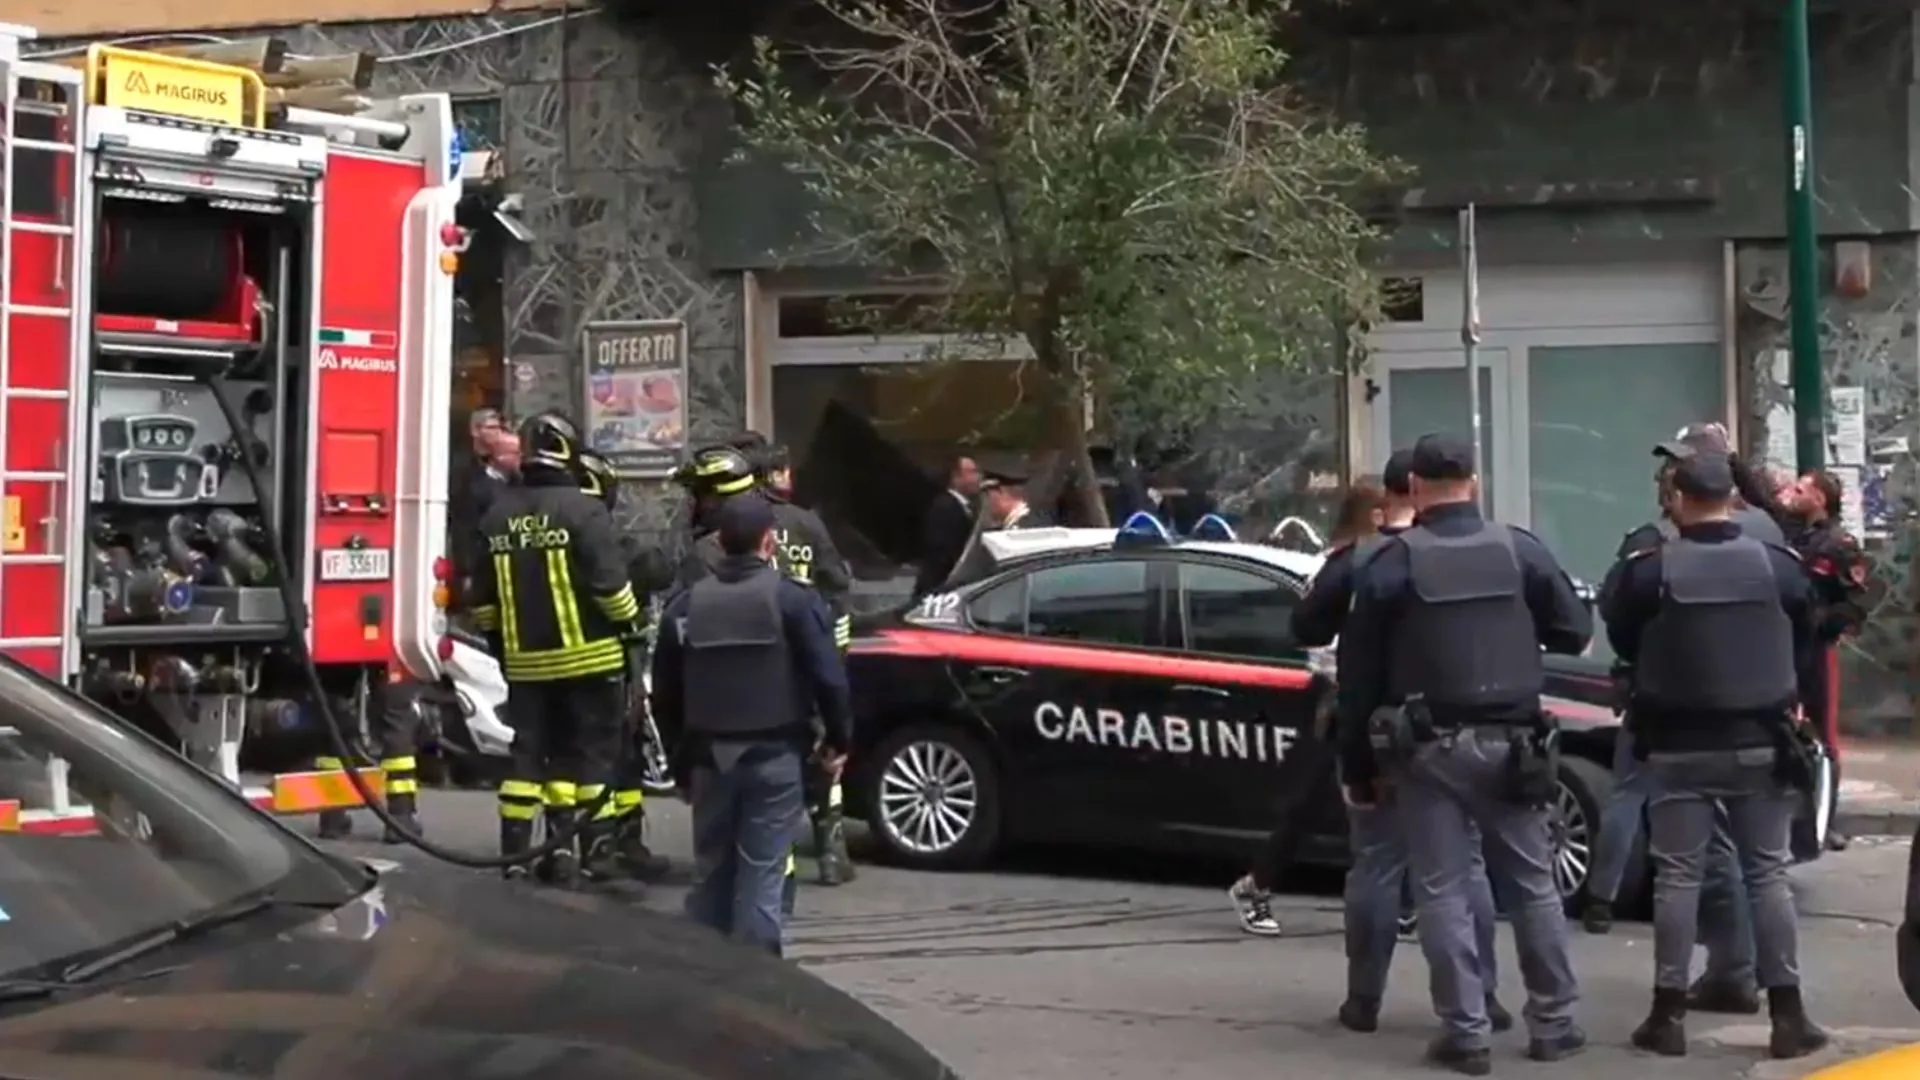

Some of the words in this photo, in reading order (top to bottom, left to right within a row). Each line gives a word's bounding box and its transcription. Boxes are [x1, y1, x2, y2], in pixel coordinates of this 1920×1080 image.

[155, 82, 228, 106] MAGIRUS
[597, 333, 676, 366] OFFERTA
[340, 355, 396, 373] MAGIRUS
[921, 591, 960, 618] 112
